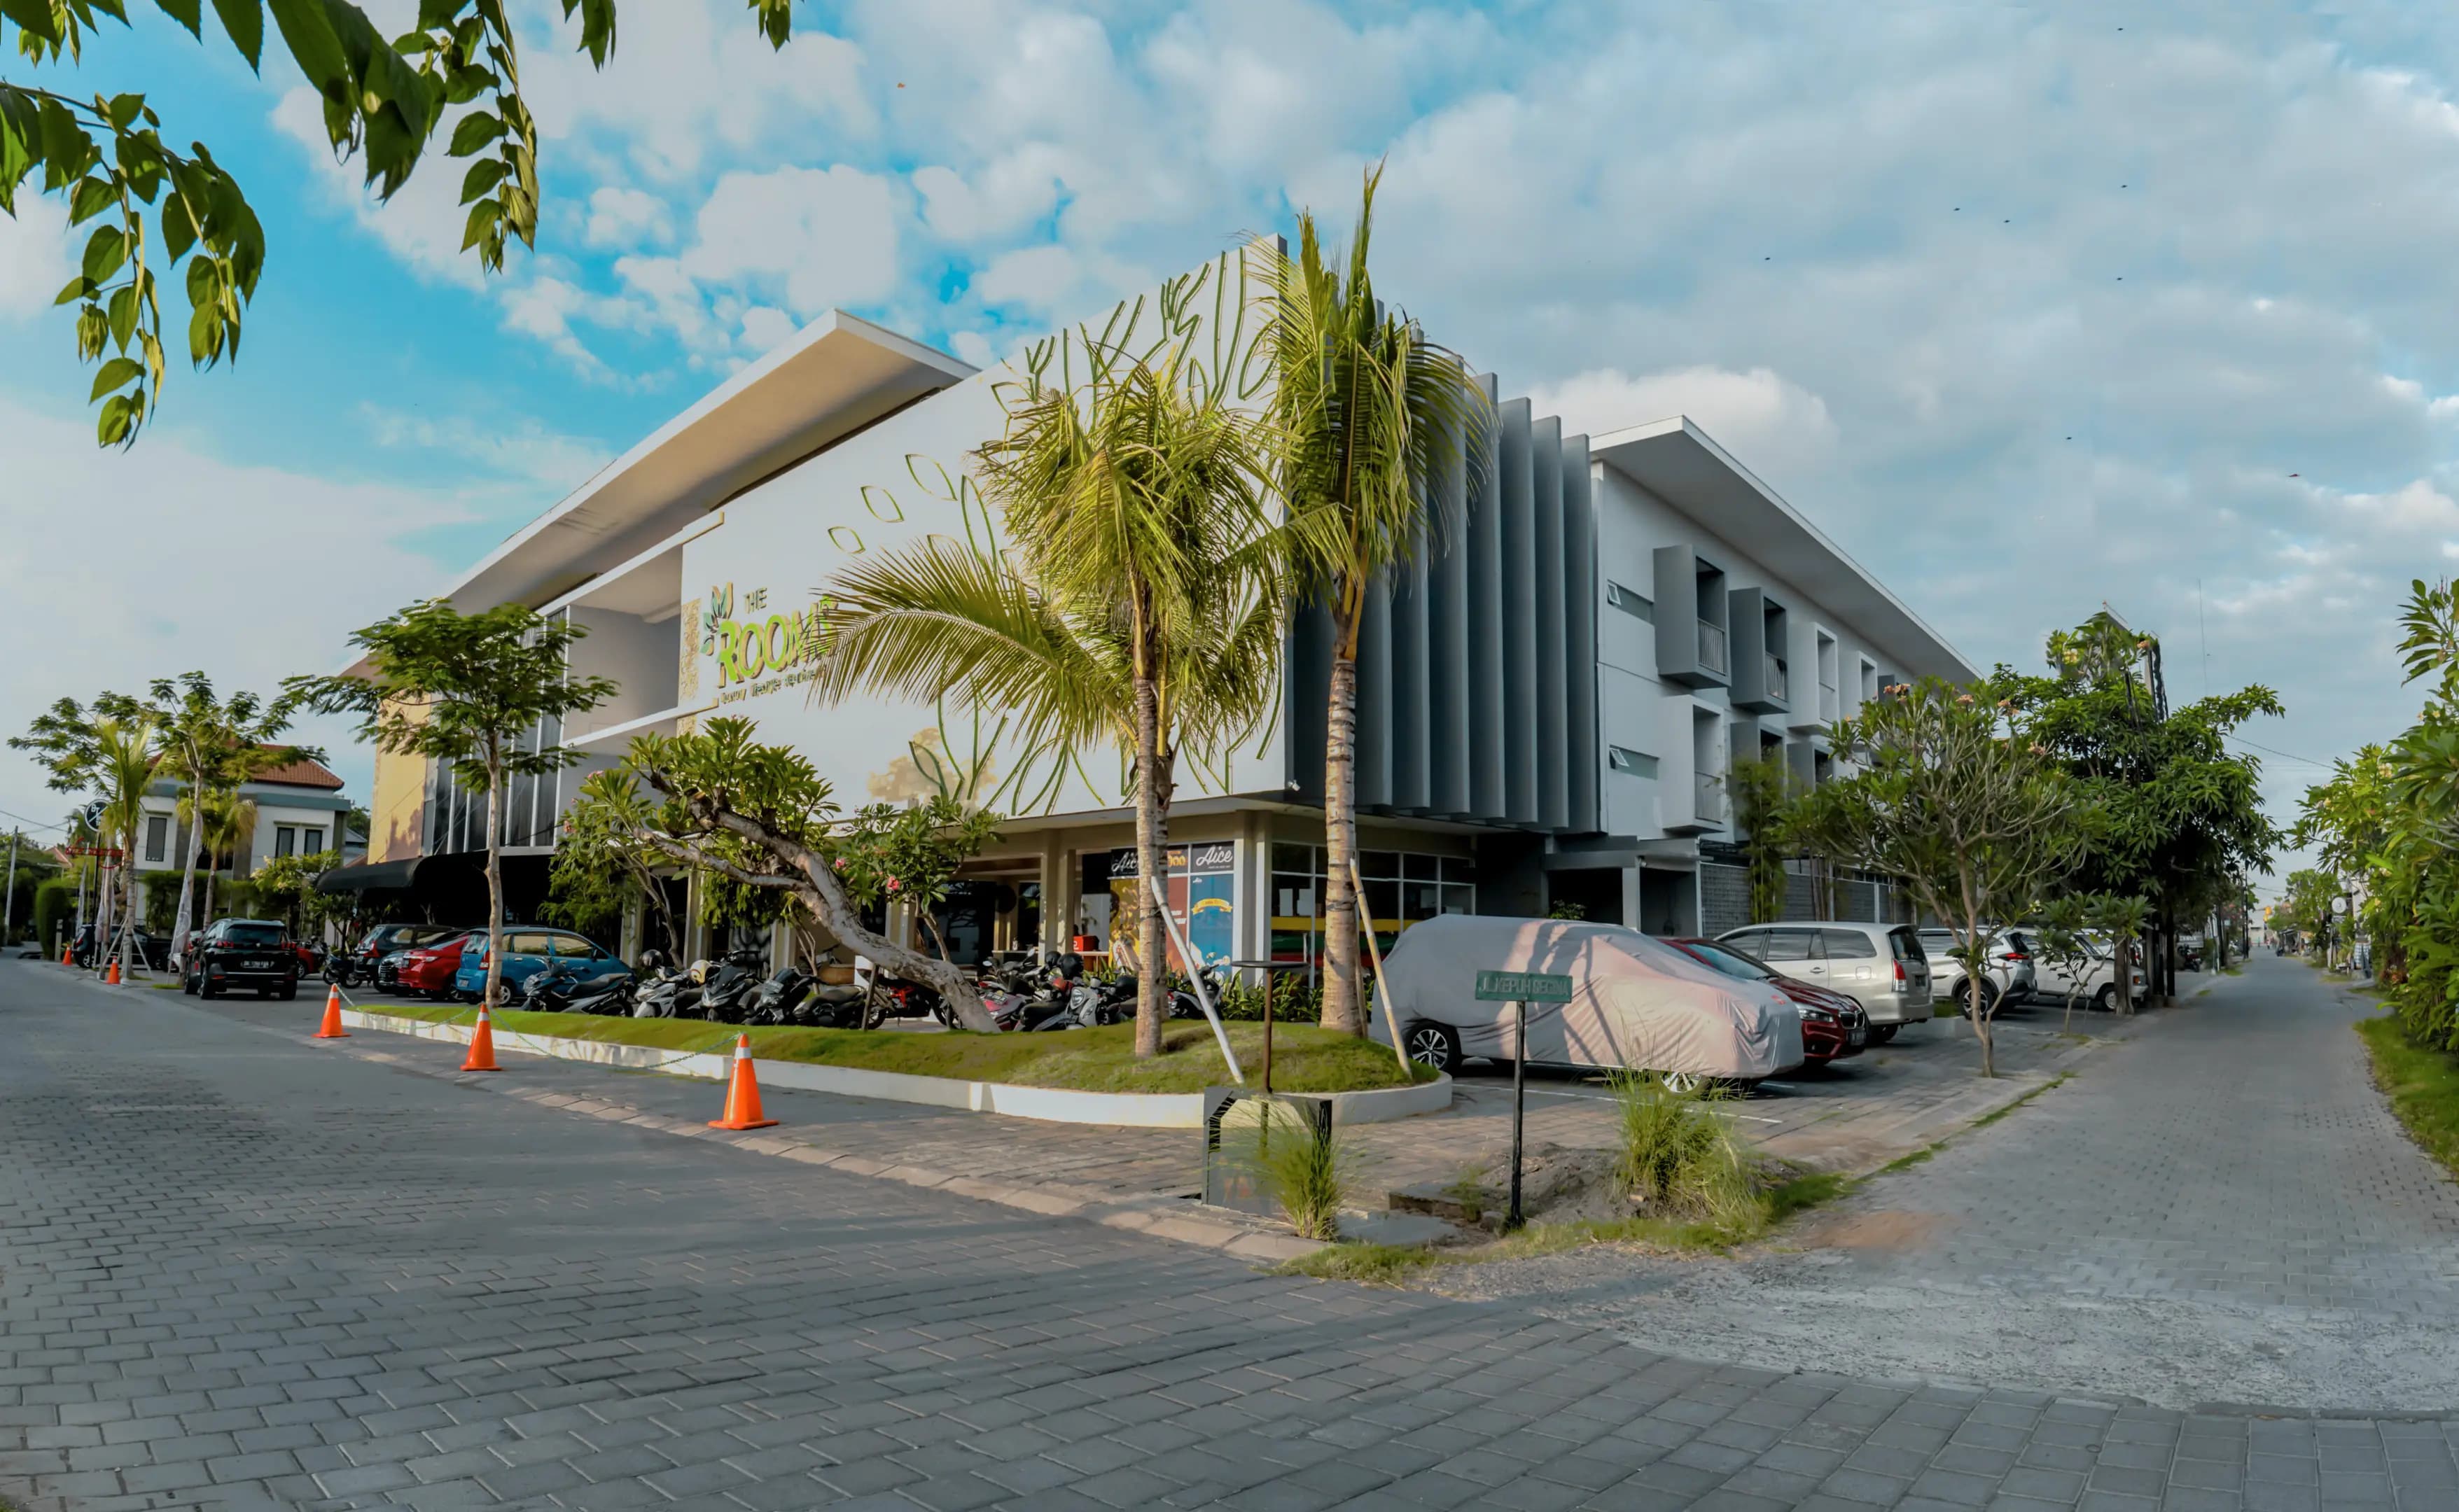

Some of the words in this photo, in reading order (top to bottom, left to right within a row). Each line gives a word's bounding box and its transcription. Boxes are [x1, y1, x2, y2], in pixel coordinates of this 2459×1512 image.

[744, 587, 767, 614] THE
[1111, 851, 1138, 872] Aic
[1196, 845, 1233, 867] Aice
